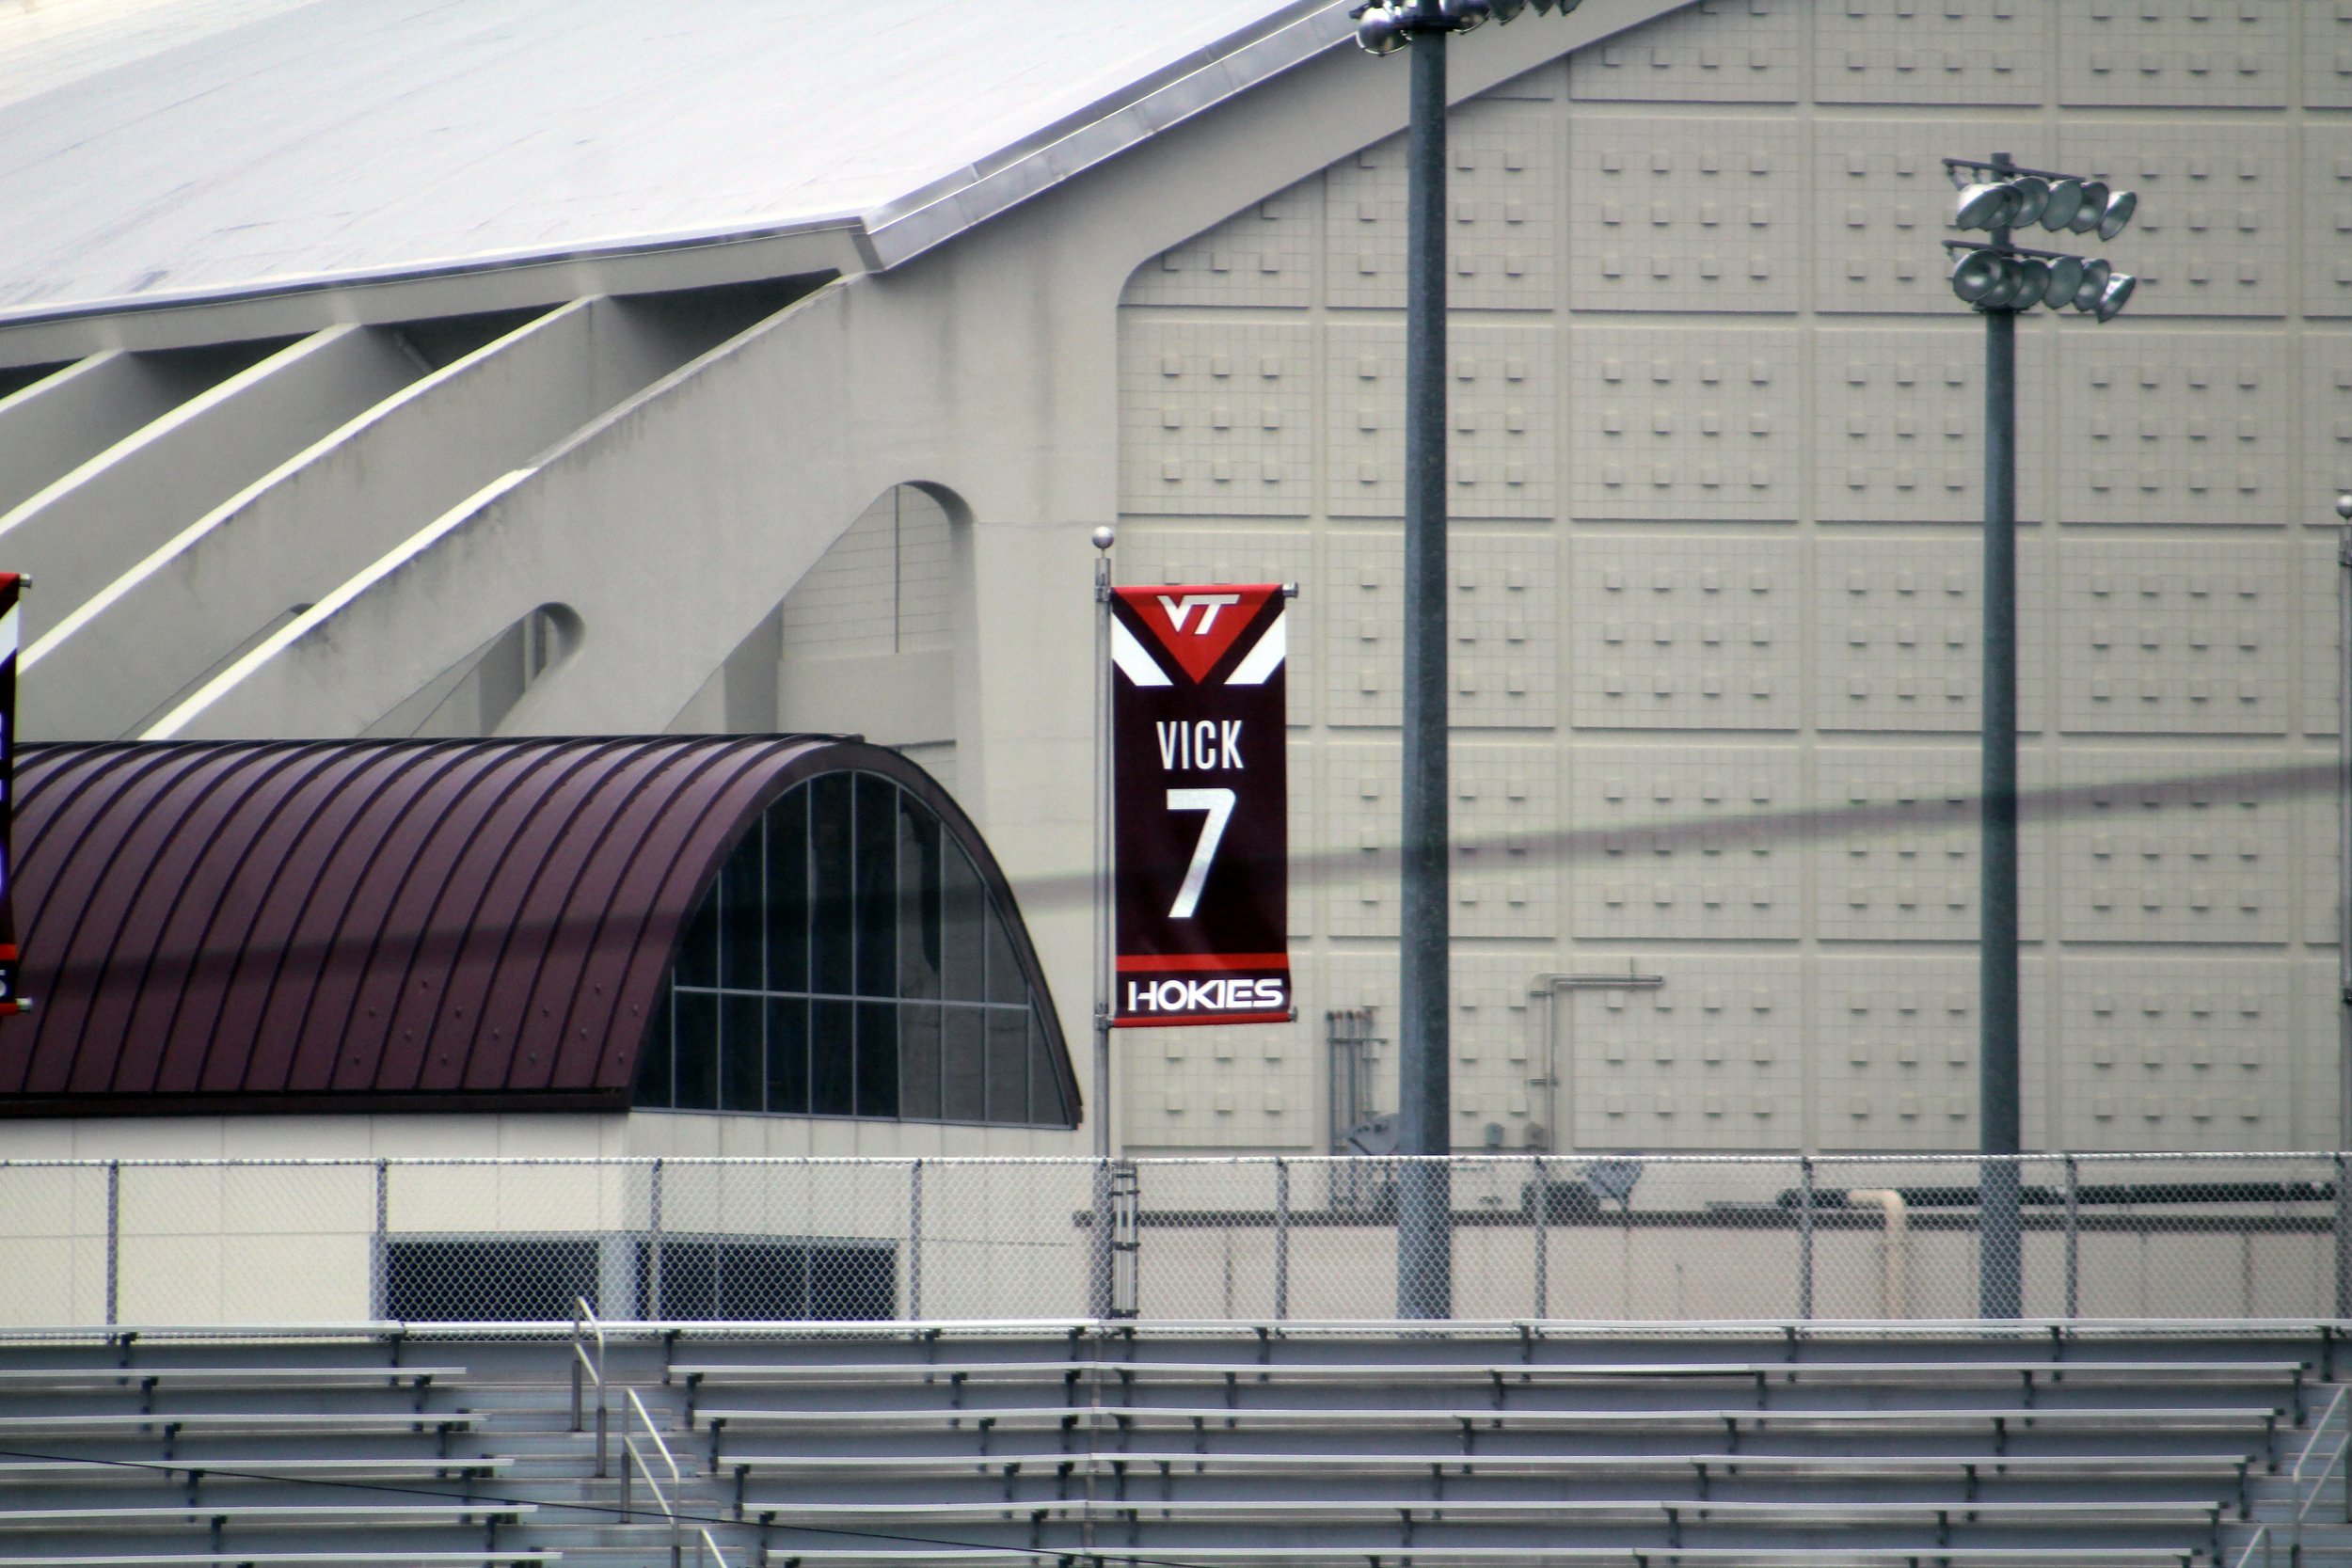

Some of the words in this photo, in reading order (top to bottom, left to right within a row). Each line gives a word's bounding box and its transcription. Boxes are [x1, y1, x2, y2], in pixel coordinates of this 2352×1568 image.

[1157, 594, 1240, 635] VT
[1156, 720, 1244, 770] VICK
[1167, 788, 1236, 918] 7
[1127, 978, 1284, 1011] HOKIES
